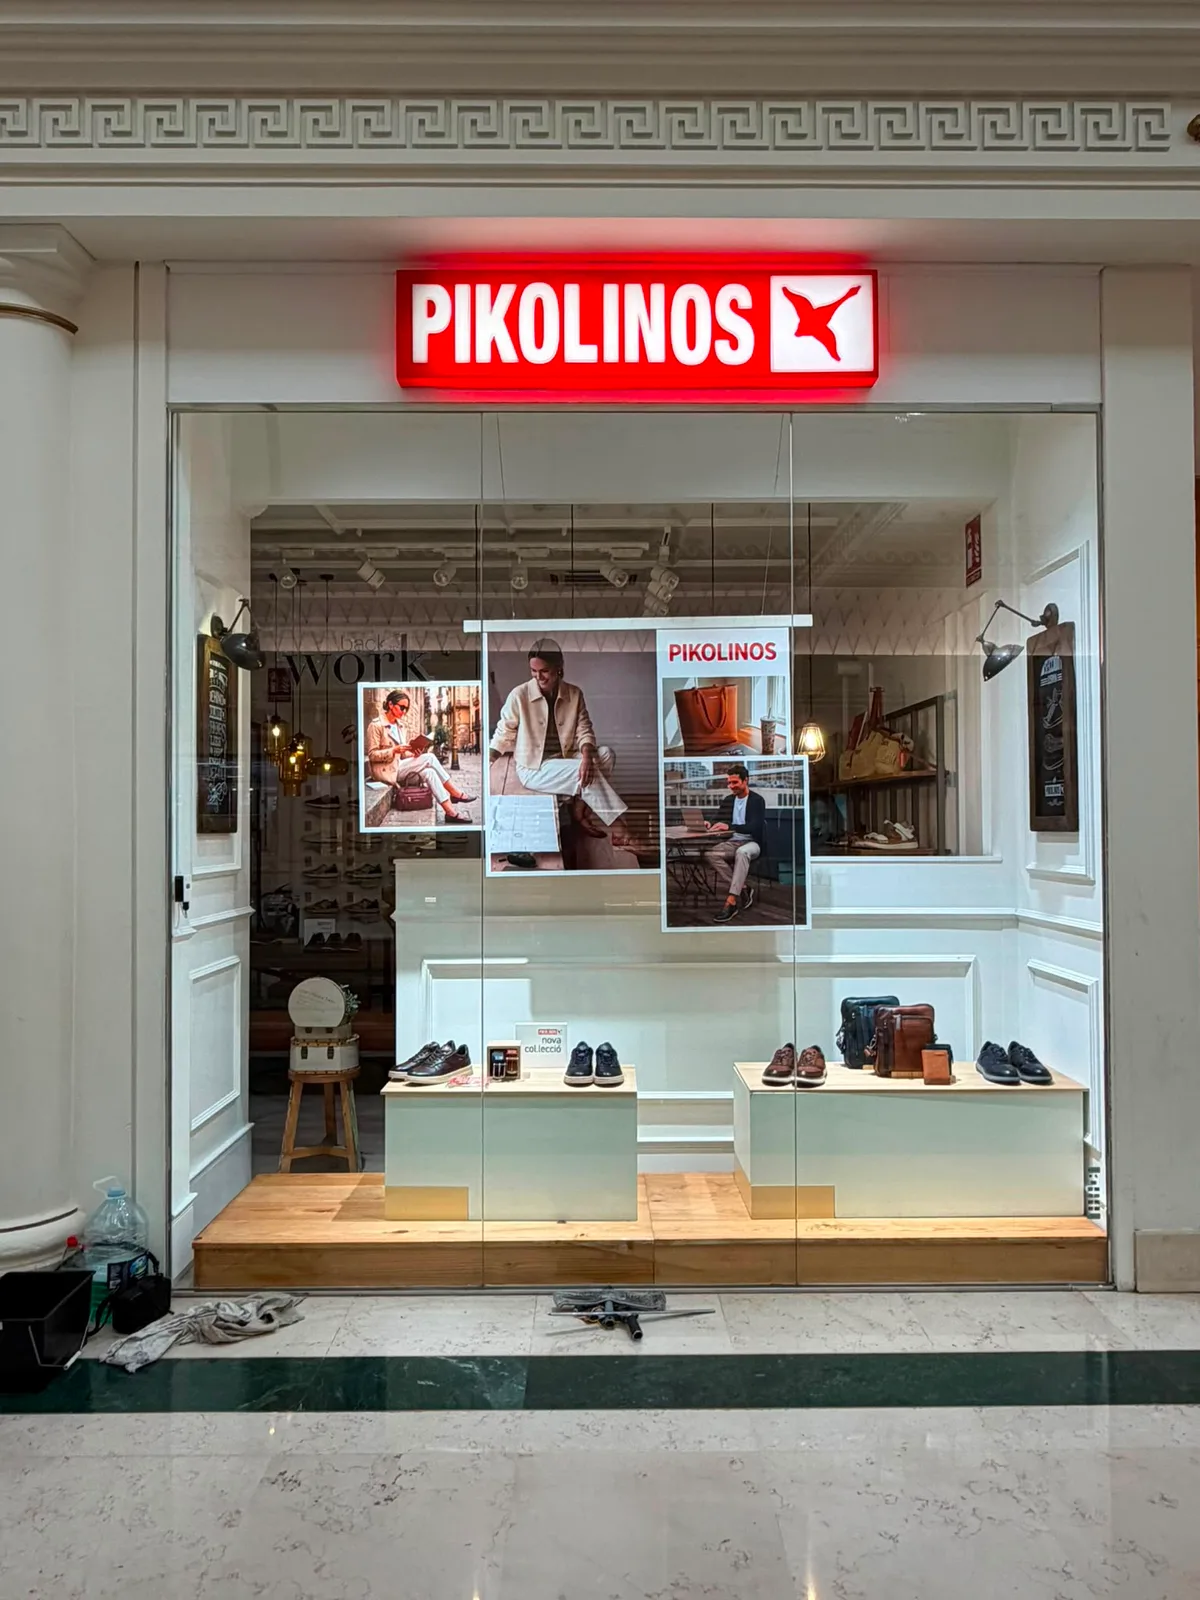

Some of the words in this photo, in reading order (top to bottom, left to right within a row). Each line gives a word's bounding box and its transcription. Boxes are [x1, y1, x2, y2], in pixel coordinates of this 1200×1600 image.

[412, 282, 755, 365] PIKOLINOS
[283, 634, 430, 686] work
[669, 642, 777, 662] PIKOLINOS
